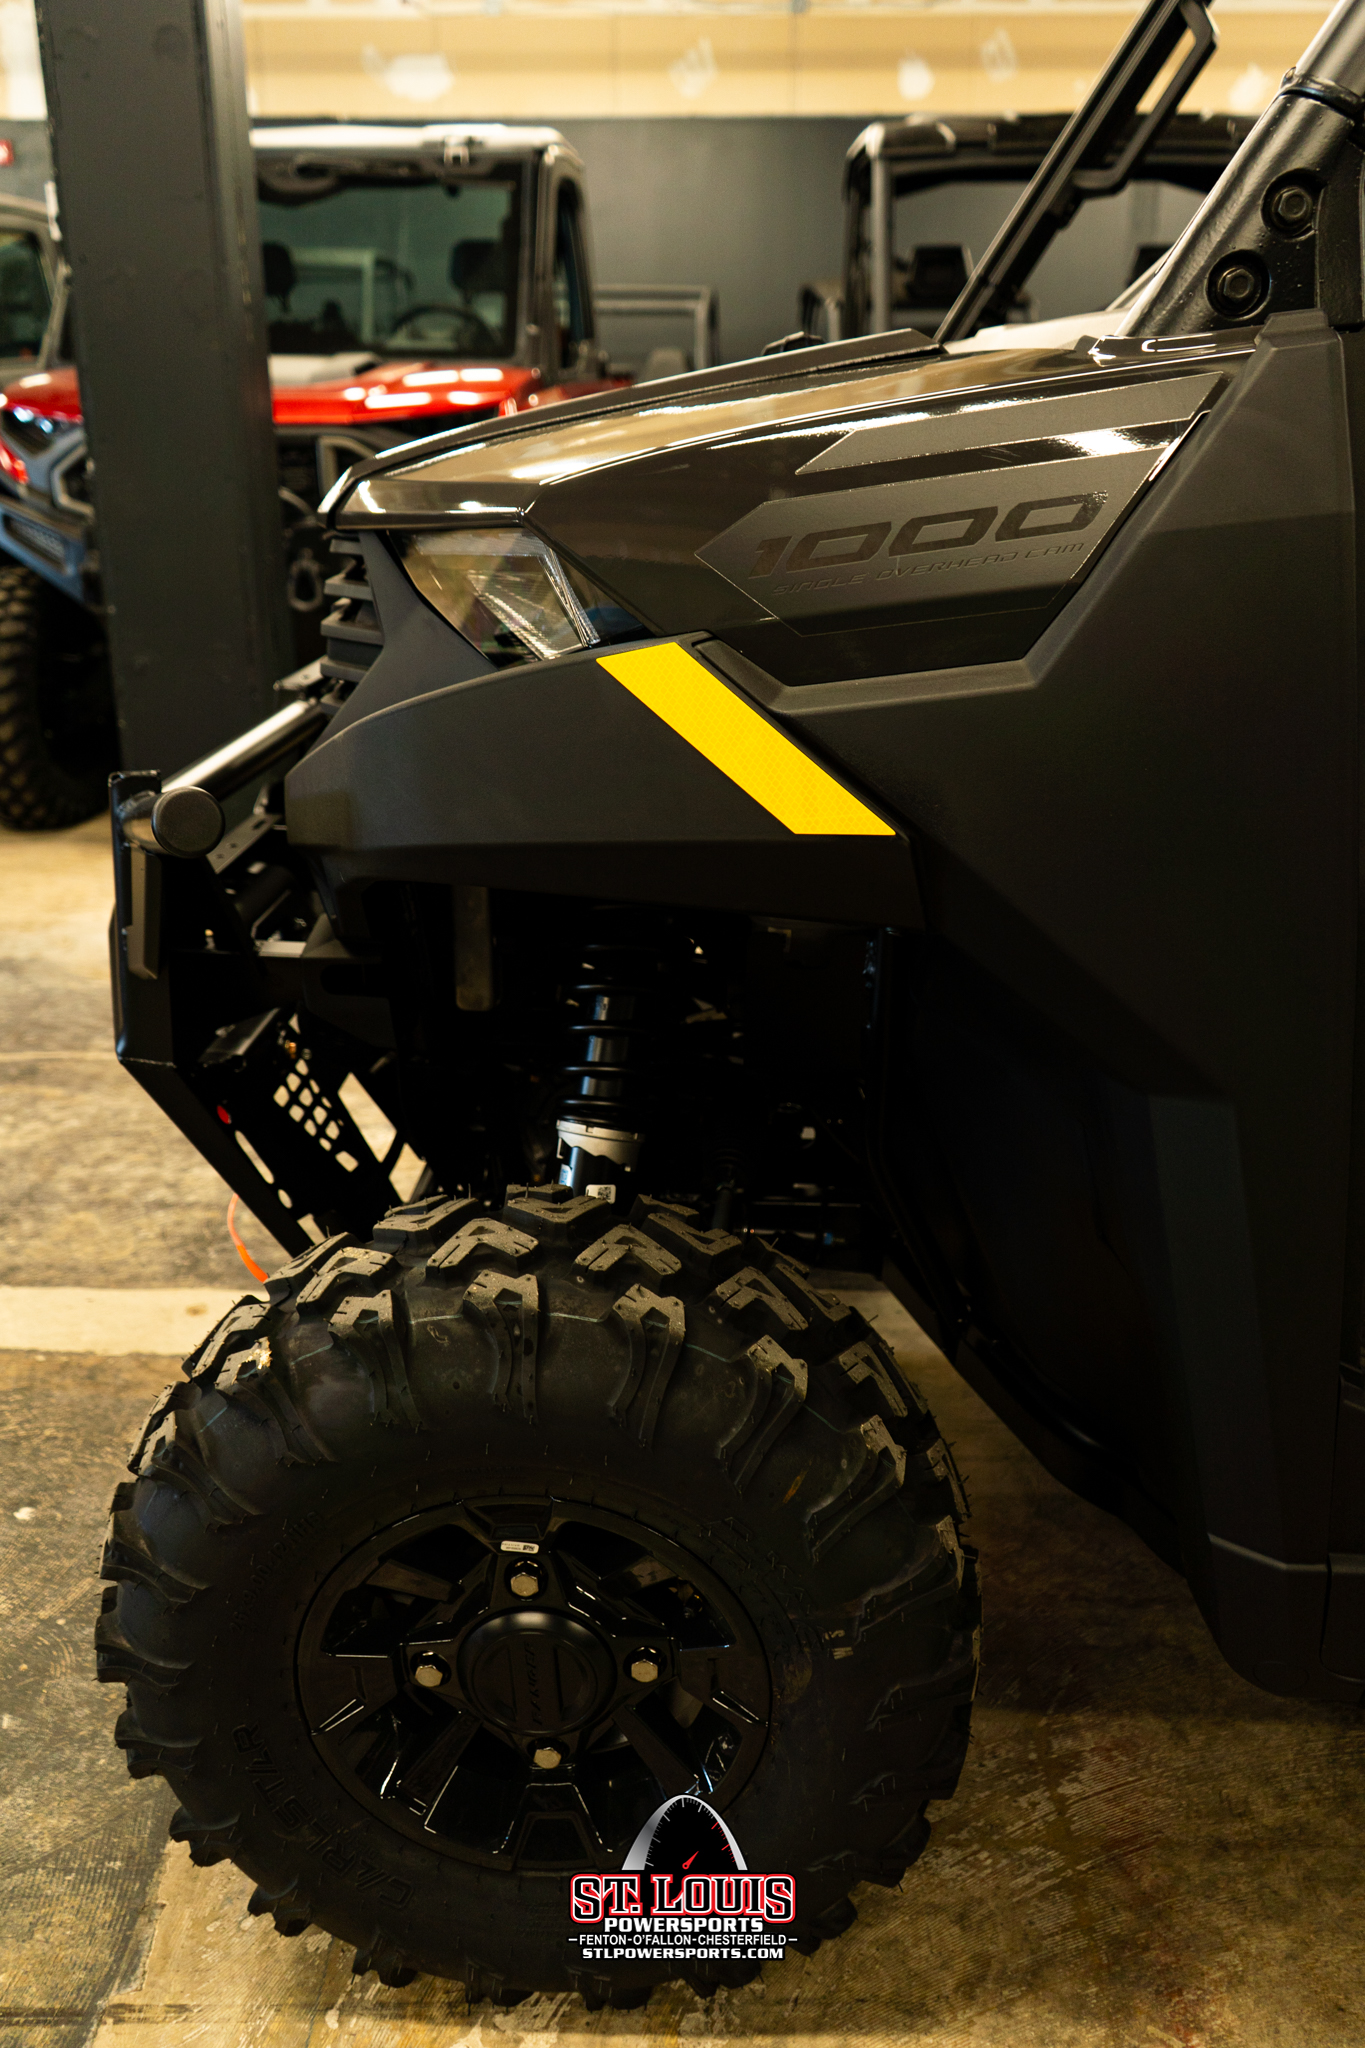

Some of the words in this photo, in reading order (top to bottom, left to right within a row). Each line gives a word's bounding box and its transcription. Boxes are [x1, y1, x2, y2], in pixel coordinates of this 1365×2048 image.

[748, 490, 1108, 579] 1000
[773, 573, 868, 596] SINGLE
[876, 551, 1018, 581] OVERHEAD
[1024, 542, 1085, 560] CAM
[231, 1721, 414, 1909] CARLSTAR
